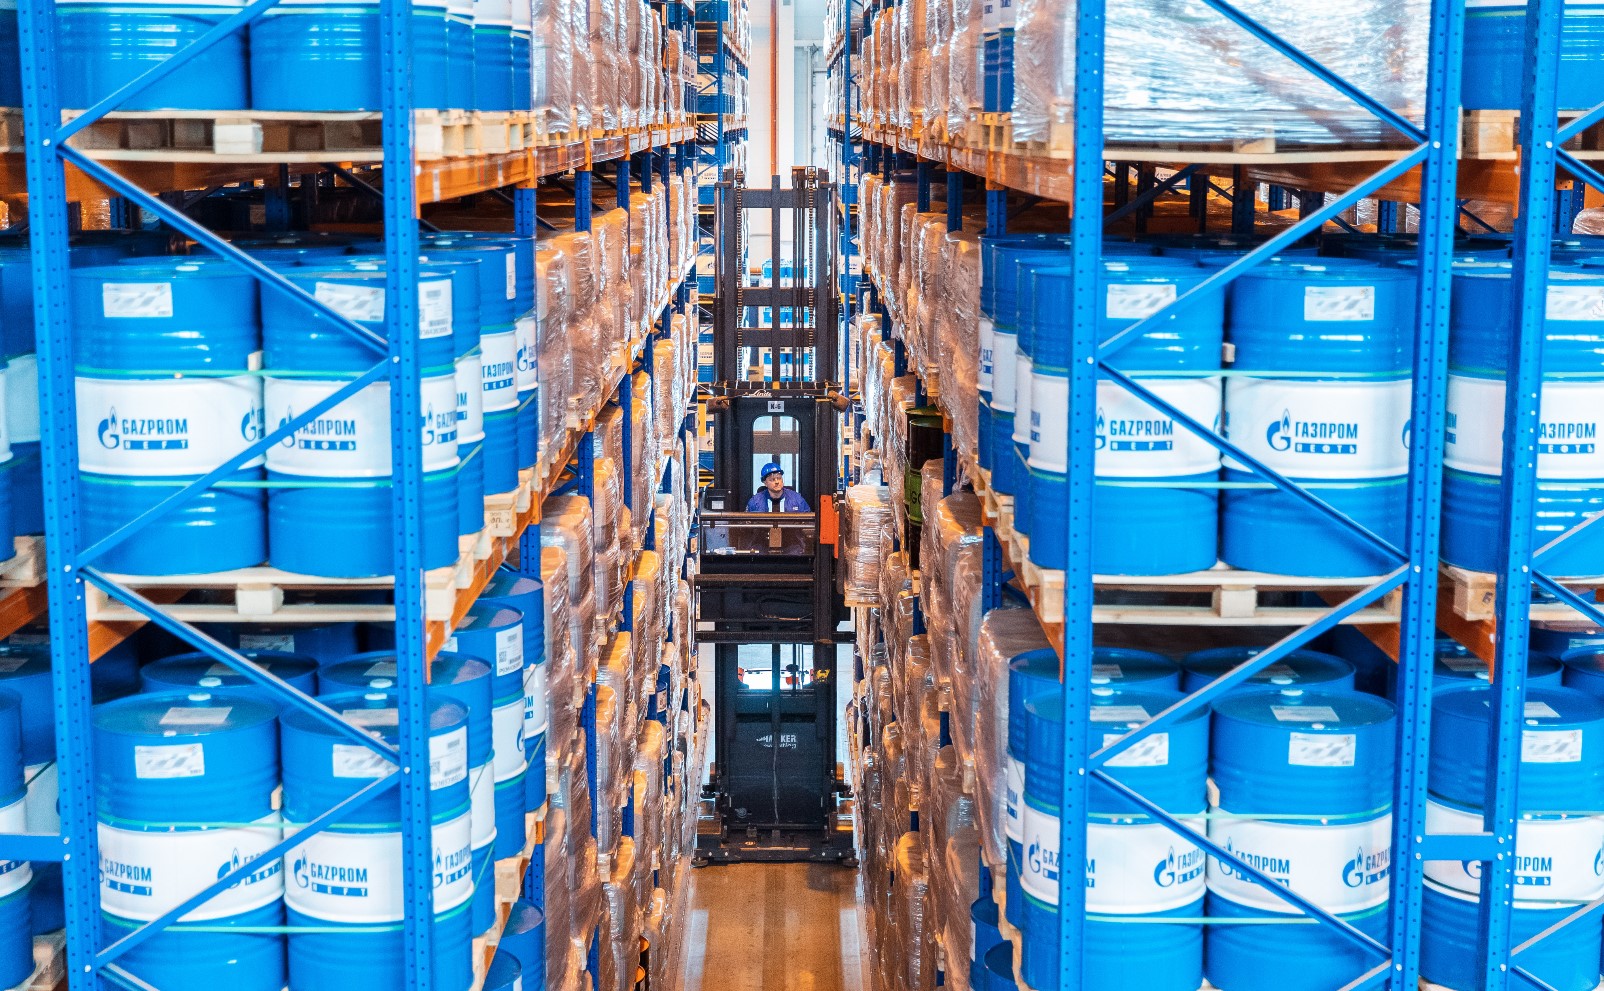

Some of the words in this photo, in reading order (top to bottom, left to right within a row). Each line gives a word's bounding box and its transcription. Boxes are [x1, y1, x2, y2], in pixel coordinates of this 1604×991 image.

[749, 389, 772, 397] Linde
[122, 418, 188, 435] GAZPROM
[298, 419, 356, 435] АЗПРОМ
[1109, 420, 1173, 436] GAZPROM
[1295, 421, 1358, 439] ГАЗПРОМ
[1540, 422, 1596, 439] АЗПРОМ
[124, 440, 188, 450] NEFT
[1110, 441, 1173, 451] NEFT
[1295, 443, 1357, 454] НЕФТЬ
[1540, 443, 1595, 454] ЕФТЬ
[104, 860, 152, 882] GAZPROM
[1516, 857, 1552, 871] ПРОМ
[310, 862, 368, 883] GAZPROM
[312, 883, 368, 897] NEFT
